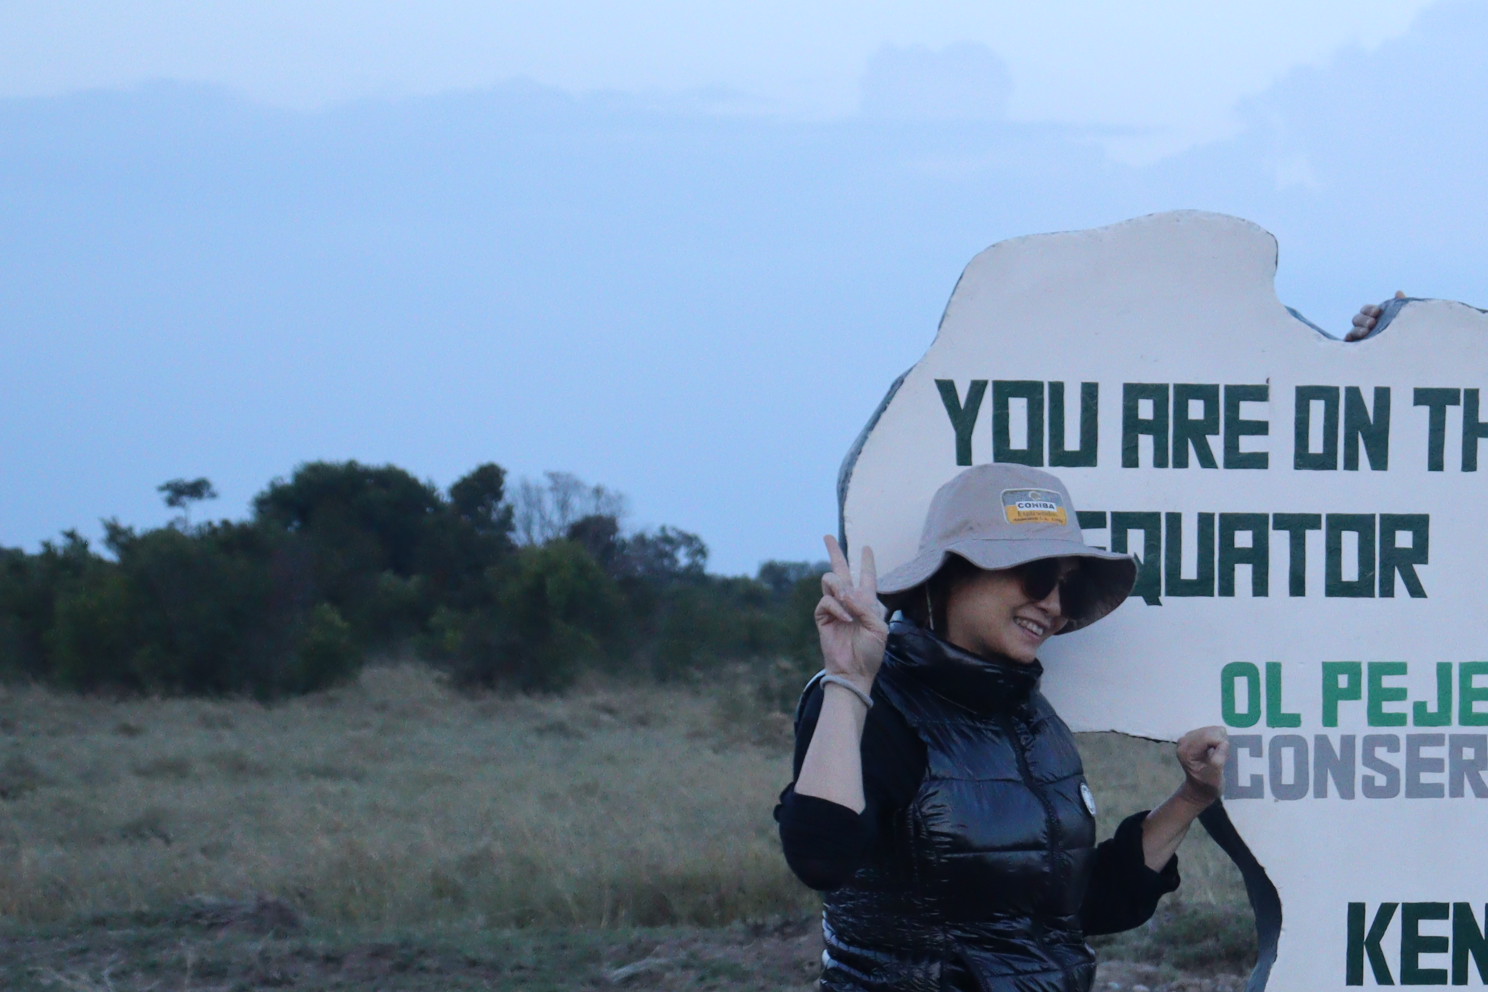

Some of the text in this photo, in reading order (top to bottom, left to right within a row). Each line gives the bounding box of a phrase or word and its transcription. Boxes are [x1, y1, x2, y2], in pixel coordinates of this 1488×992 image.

[935, 379, 1098, 467] YOU
[1122, 383, 1269, 469] ARE
[1294, 386, 1390, 471] ON
[1220, 661, 1301, 728] OL
